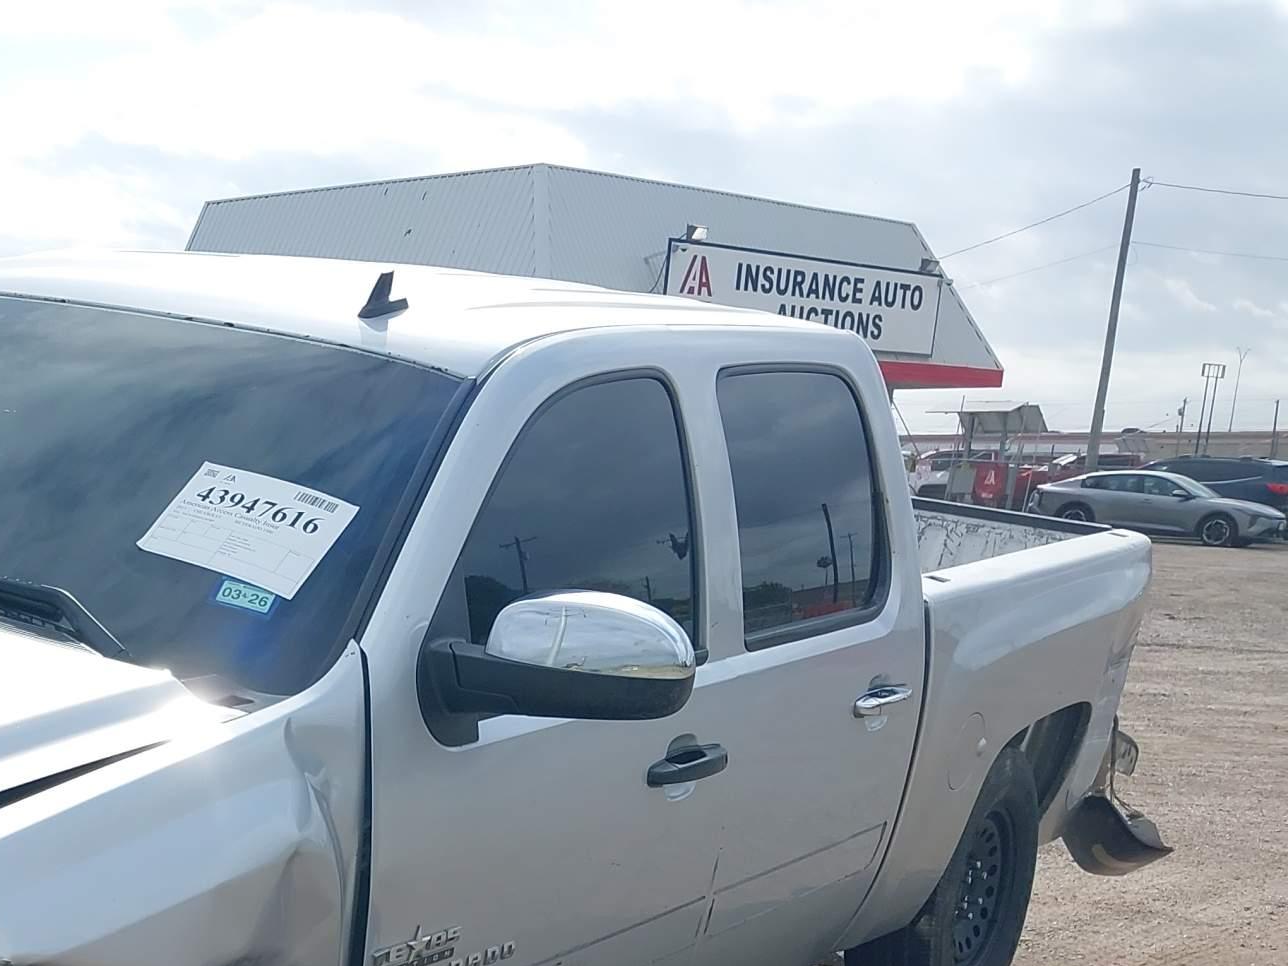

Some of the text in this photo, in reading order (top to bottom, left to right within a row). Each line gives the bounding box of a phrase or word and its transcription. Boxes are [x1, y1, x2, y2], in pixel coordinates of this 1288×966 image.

[735, 262, 924, 312] INSURANCE AUTO
[196, 486, 325, 534] 43947616
[372, 925, 463, 966] TEXAS
